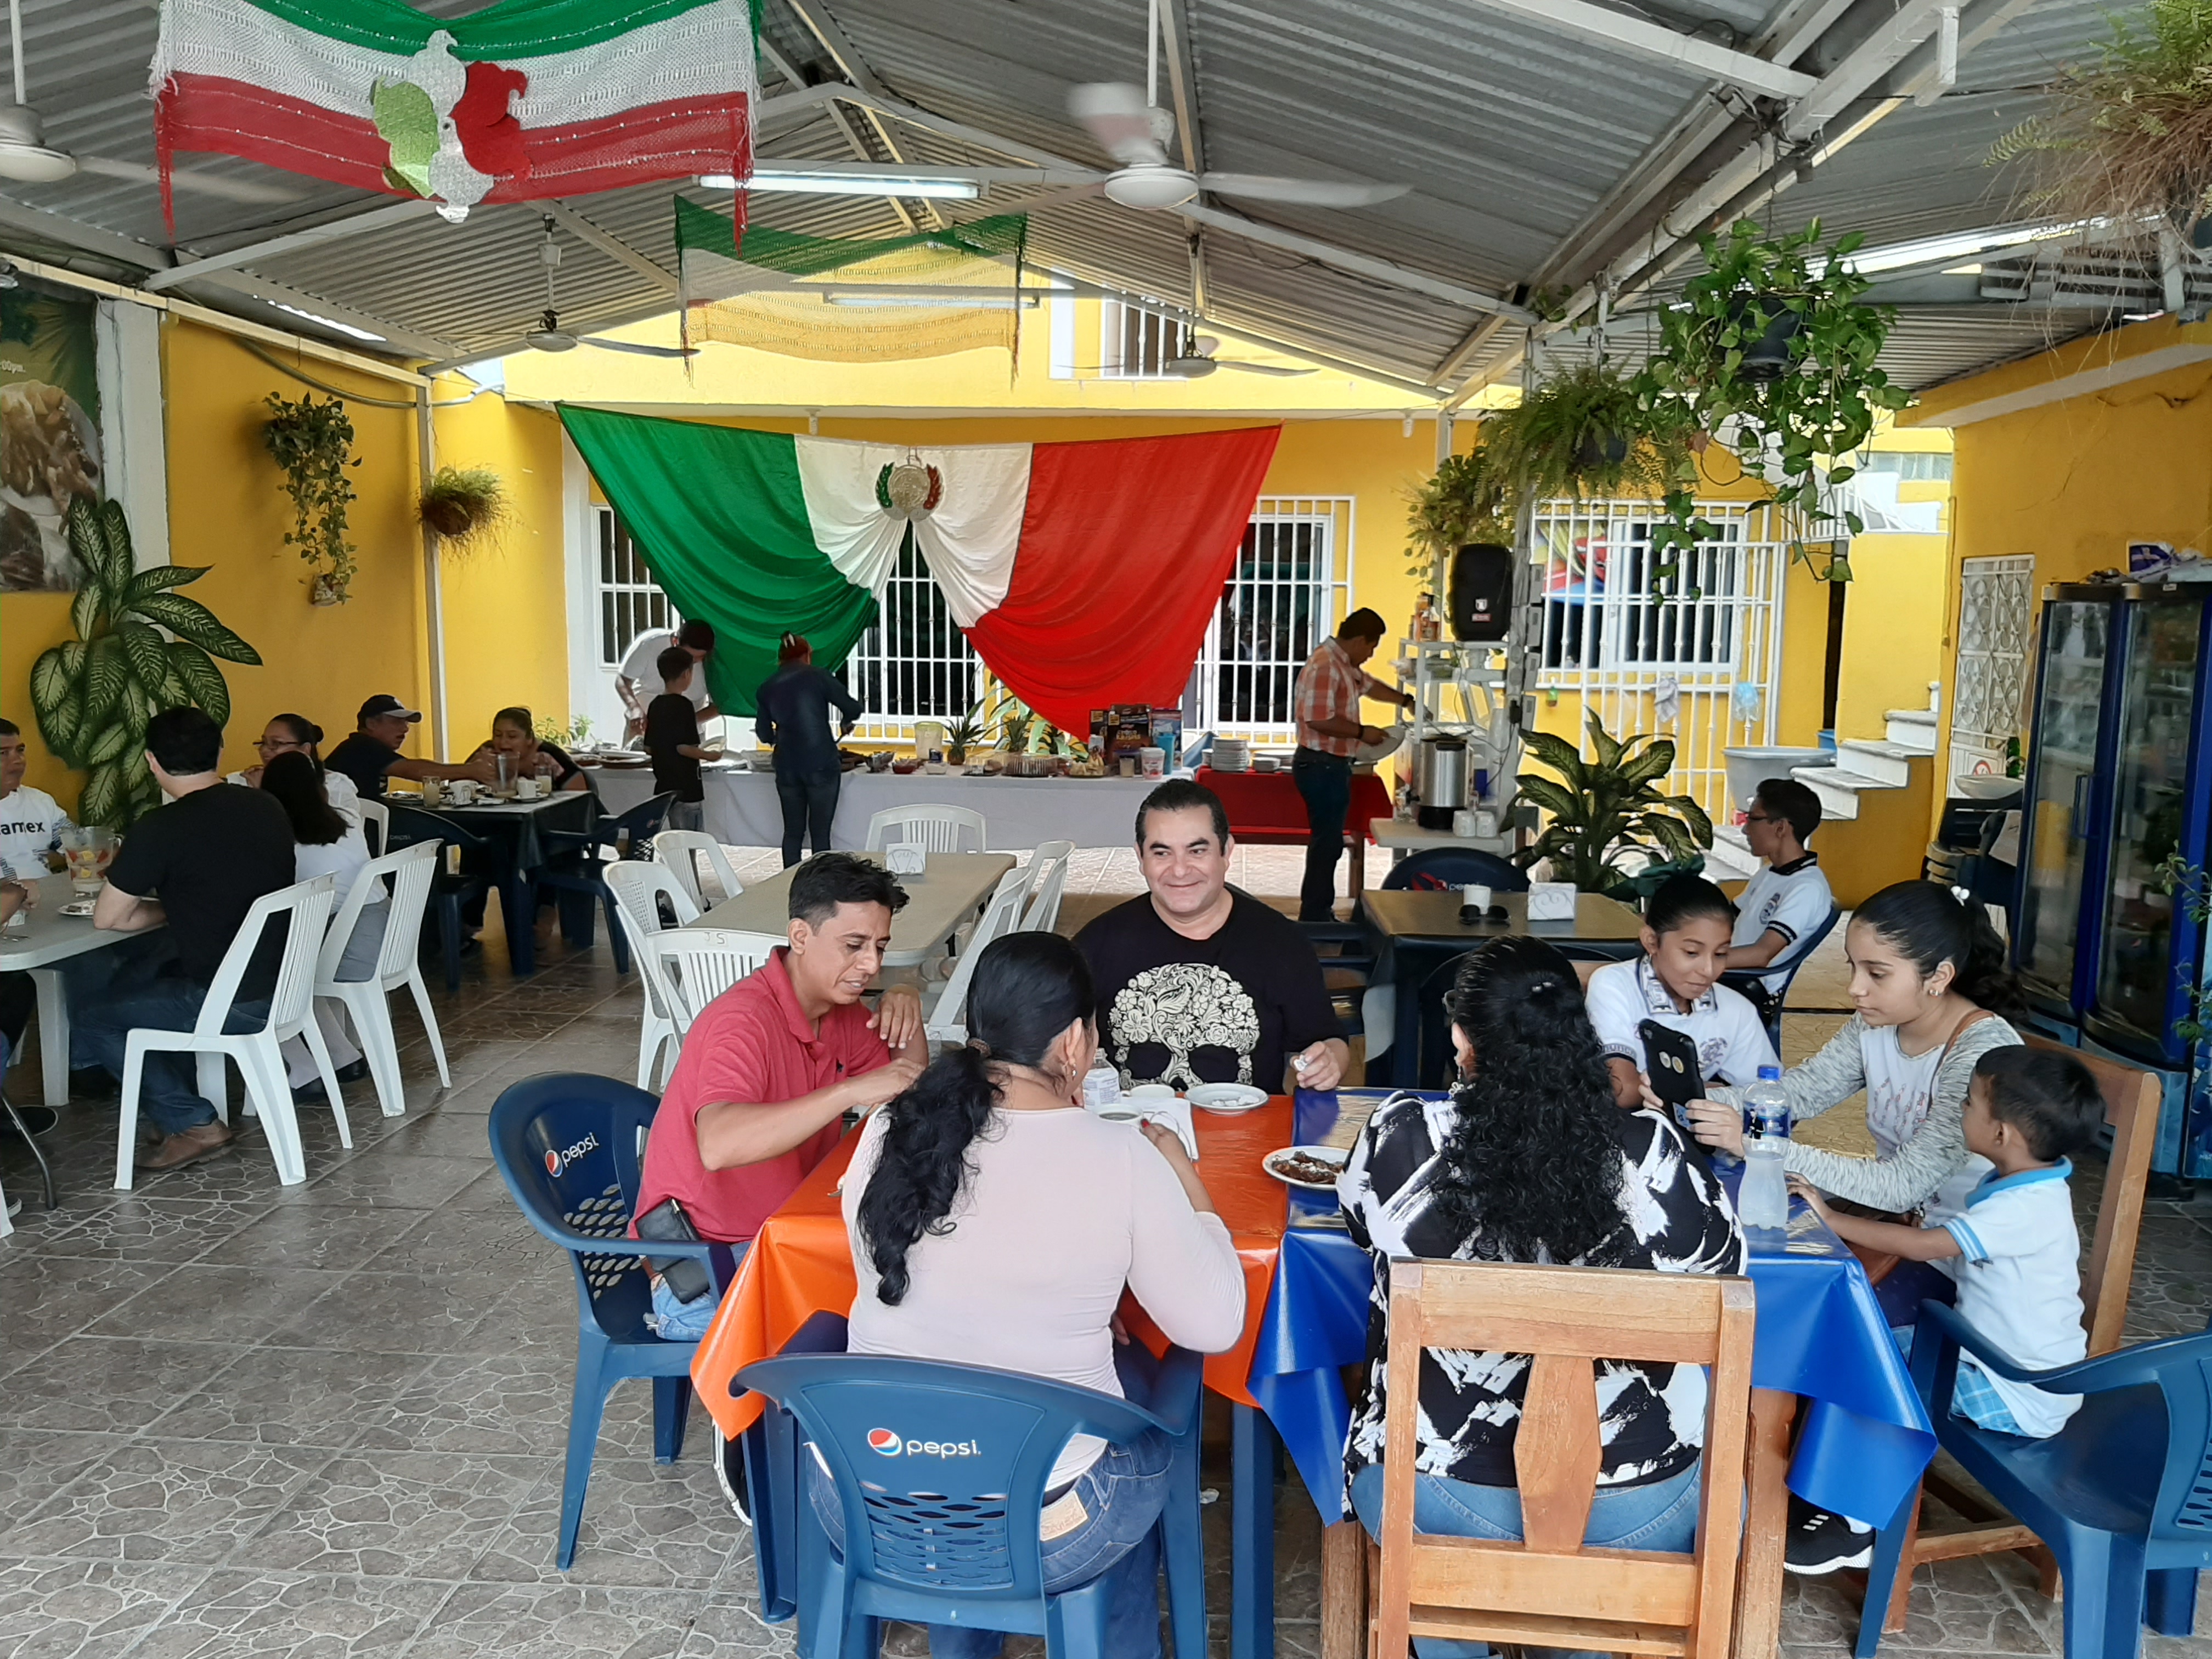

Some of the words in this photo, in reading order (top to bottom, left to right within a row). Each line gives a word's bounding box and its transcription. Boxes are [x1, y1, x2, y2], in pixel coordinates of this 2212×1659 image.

[0, 822, 46, 835] amex
[561, 1132, 599, 1167] pepsi
[906, 1440, 978, 1459] pepsi
